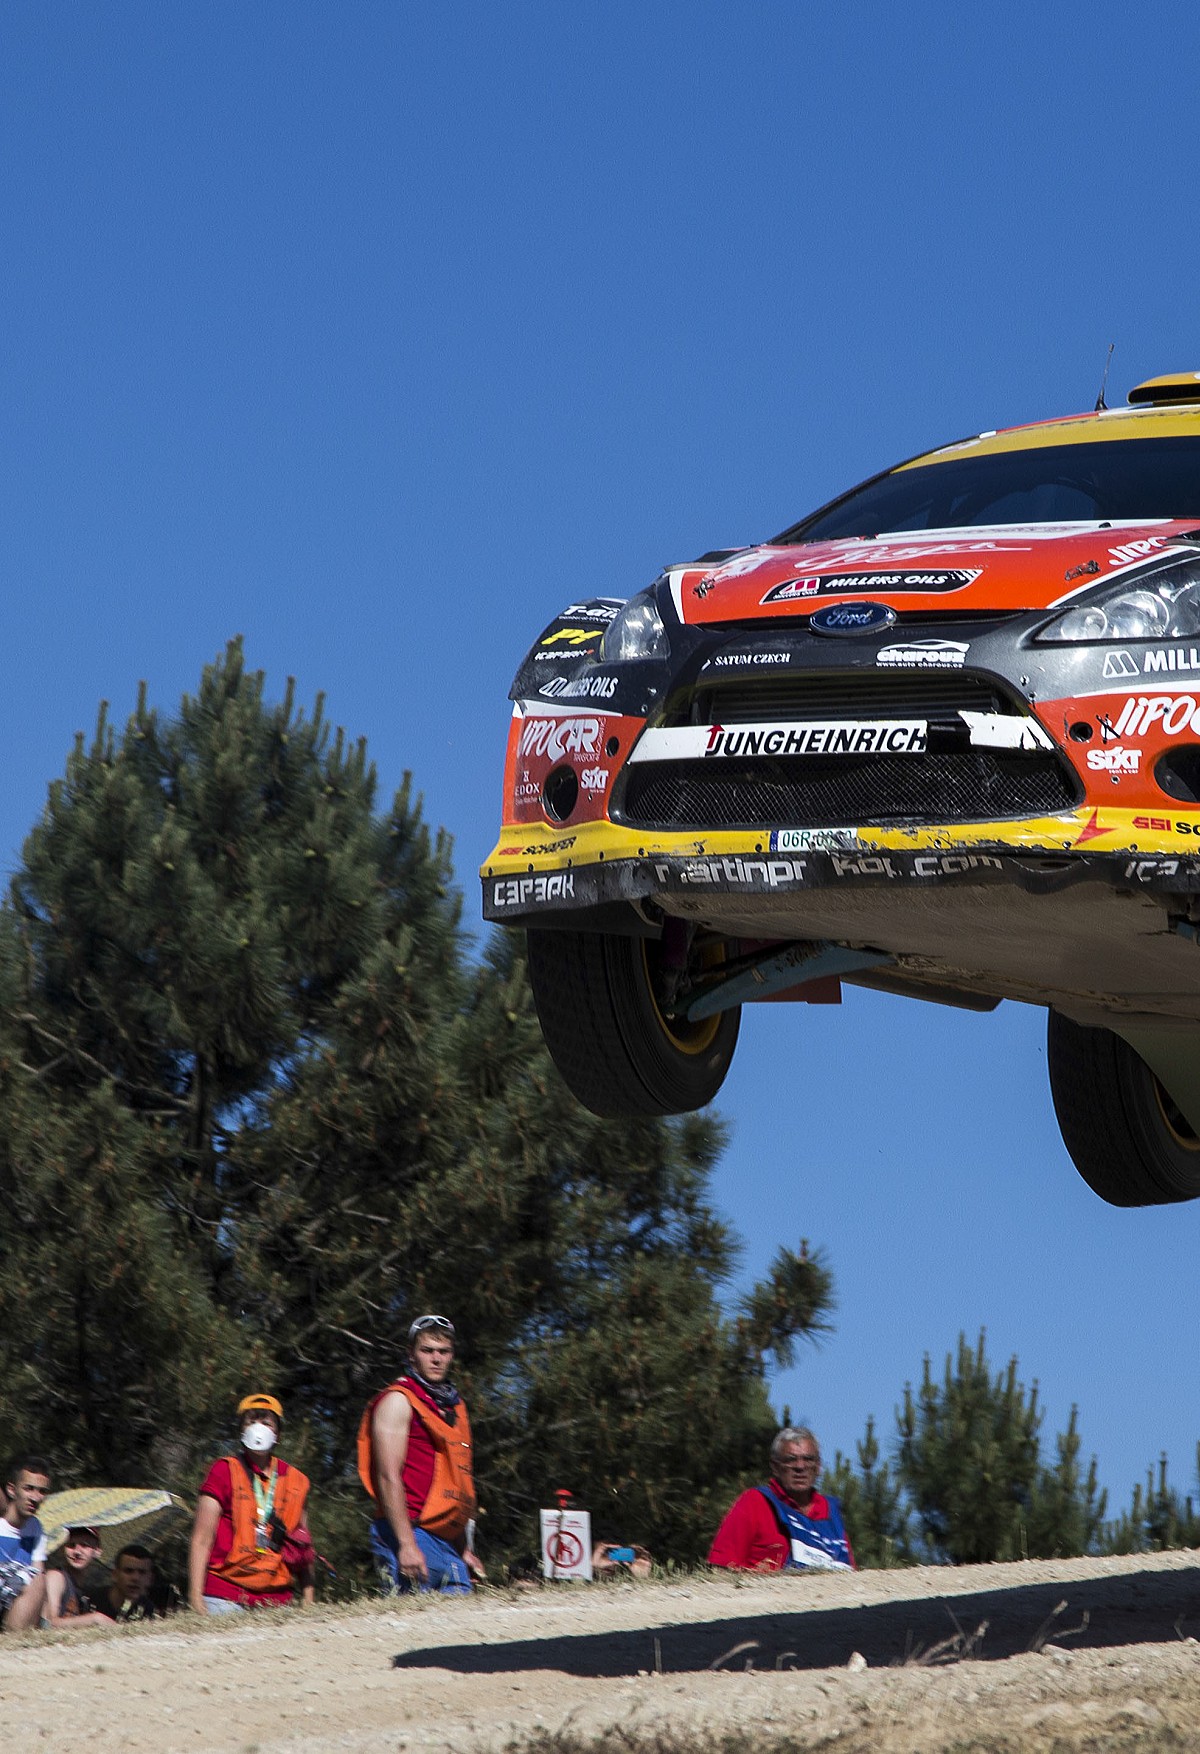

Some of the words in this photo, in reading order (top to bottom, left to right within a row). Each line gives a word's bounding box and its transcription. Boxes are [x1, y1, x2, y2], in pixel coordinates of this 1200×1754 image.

[825, 577, 899, 588] MILLERS
[904, 575, 948, 585] OILS
[826, 607, 872, 627] Ford
[590, 676, 618, 698] OILS
[705, 727, 927, 756] JUNGHEINRICH
[514, 783, 540, 797] EDOX
